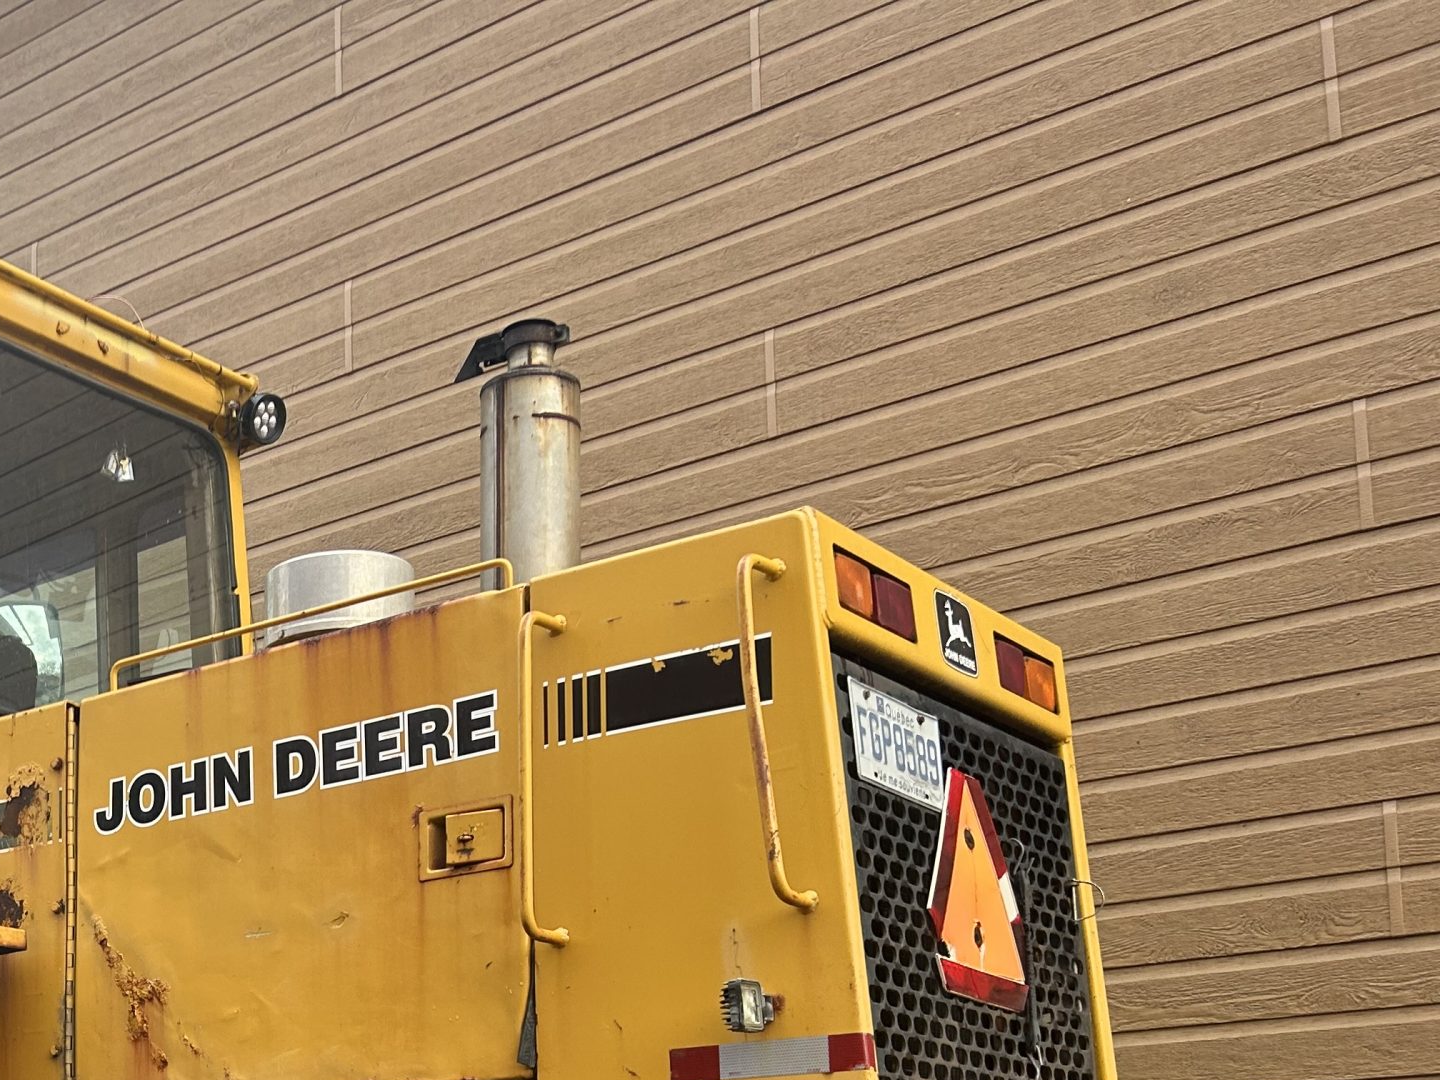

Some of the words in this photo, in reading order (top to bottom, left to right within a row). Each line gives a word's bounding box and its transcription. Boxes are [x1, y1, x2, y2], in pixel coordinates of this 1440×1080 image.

[94, 746, 254, 835] JOHN
[273, 690, 499, 799] DEERE
[856, 704, 940, 786] FGP8589
